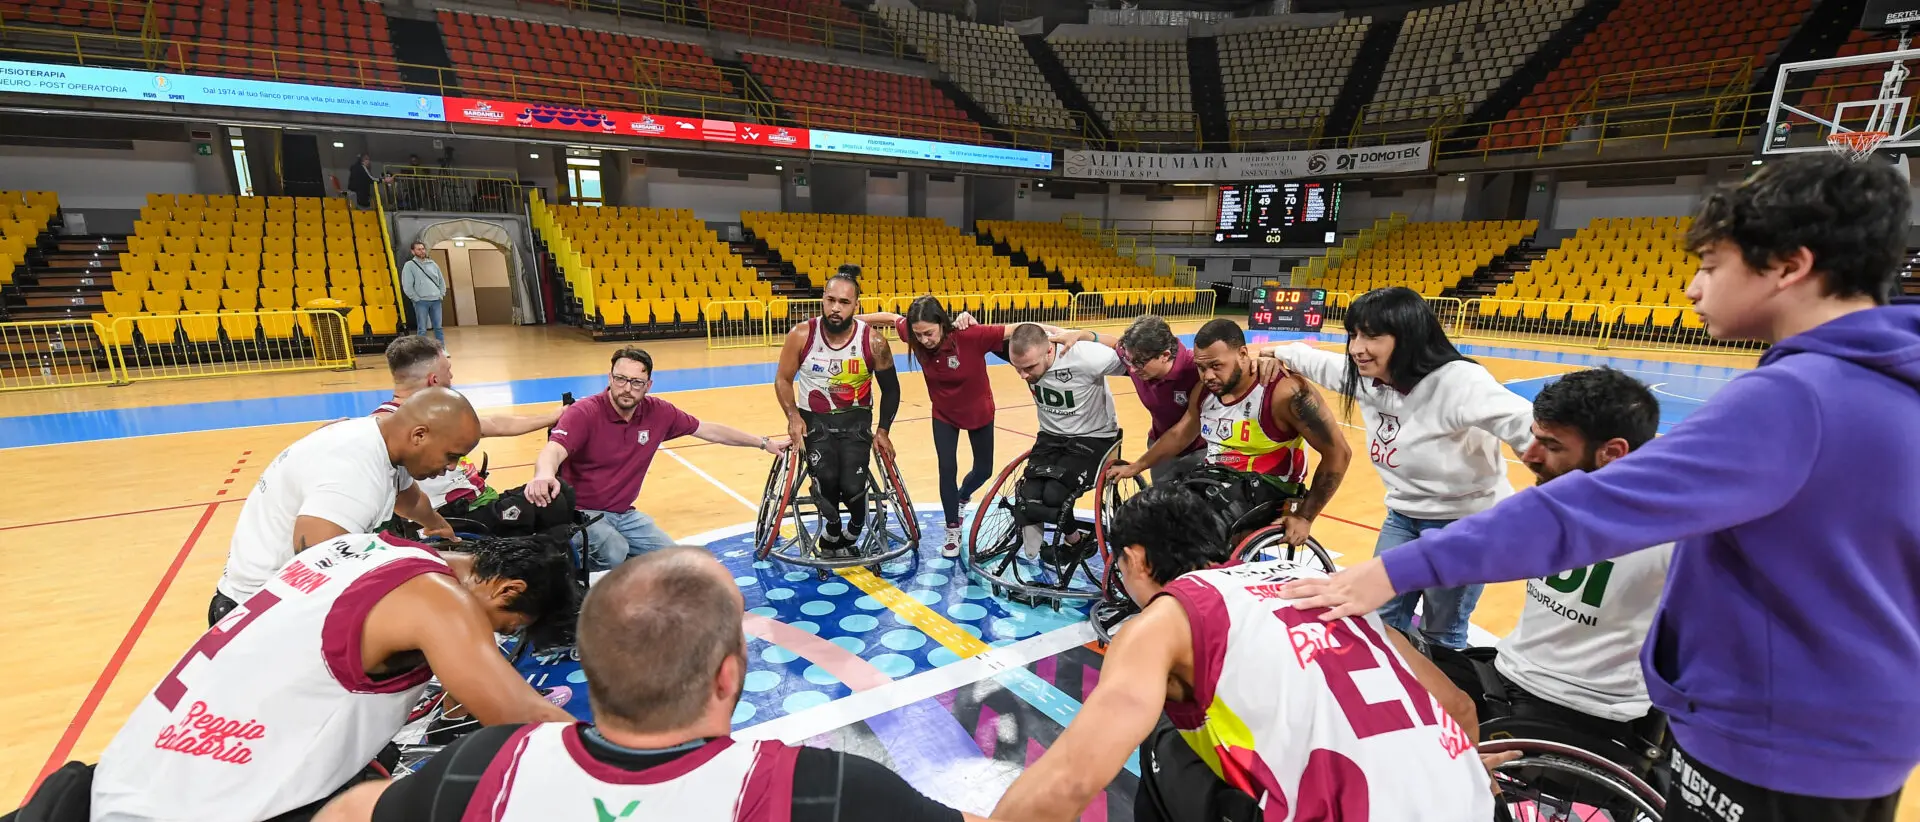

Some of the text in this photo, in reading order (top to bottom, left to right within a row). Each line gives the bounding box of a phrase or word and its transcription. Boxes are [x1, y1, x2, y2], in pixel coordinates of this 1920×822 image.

[40, 81, 65, 89] POST
[68, 82, 127, 93] OPERATORIA
[218, 88, 236, 96] 1974
[1361, 147, 1420, 162] DOMOTEK
[1089, 153, 1228, 169] ALTAFIUMARA
[1087, 168, 1126, 177] RESORT
[1258, 197, 1271, 205] 49
[1284, 197, 1297, 205] 70
[1266, 234, 1281, 243] 0:0
[1260, 290, 1266, 298] 3
[1276, 291, 1300, 303] 0:0
[1318, 291, 1325, 300] 3
[1255, 312, 1272, 324] 49
[1304, 314, 1320, 326] 70
[848, 359, 859, 374] 10
[1240, 420, 1250, 442] 6
[180, 701, 265, 742] Reggio
[155, 724, 252, 766] Calabria
